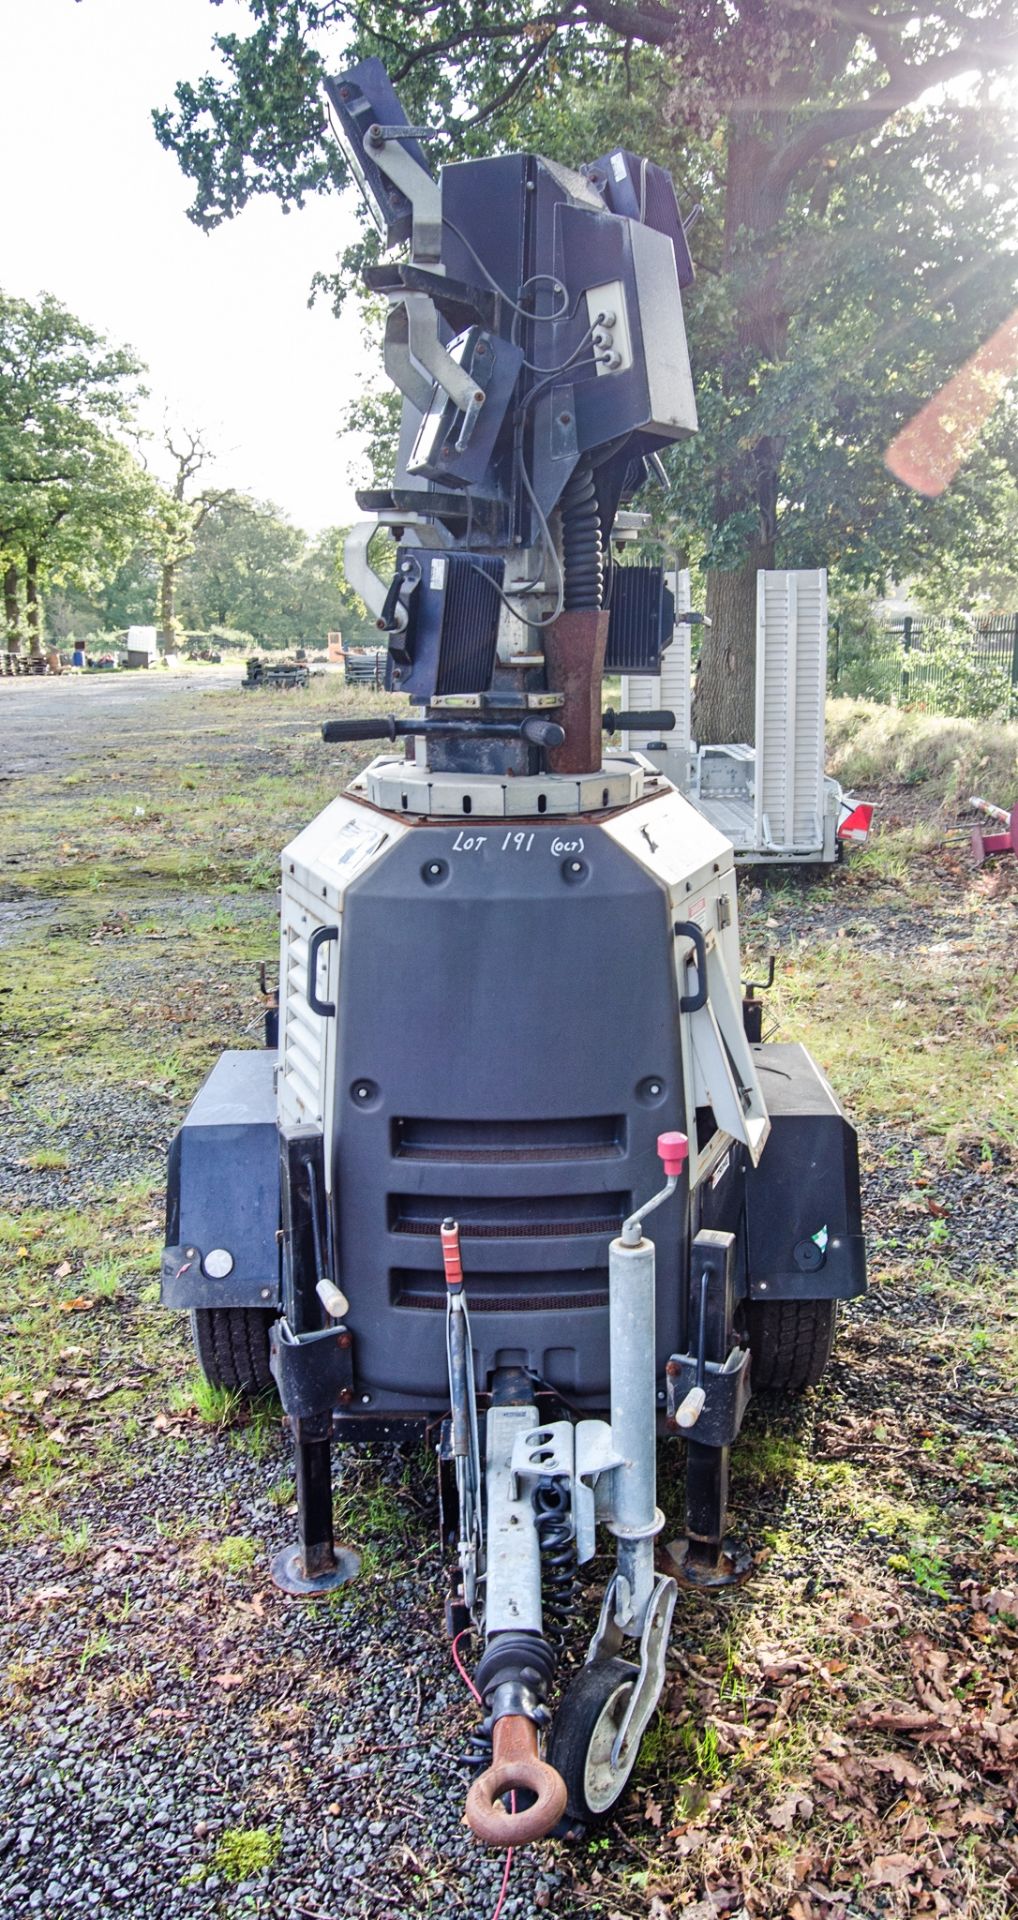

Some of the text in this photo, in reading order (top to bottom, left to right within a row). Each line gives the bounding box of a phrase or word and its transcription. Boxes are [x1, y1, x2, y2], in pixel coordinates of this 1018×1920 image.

[452, 831, 584, 856] LOT 191 (OCT)
